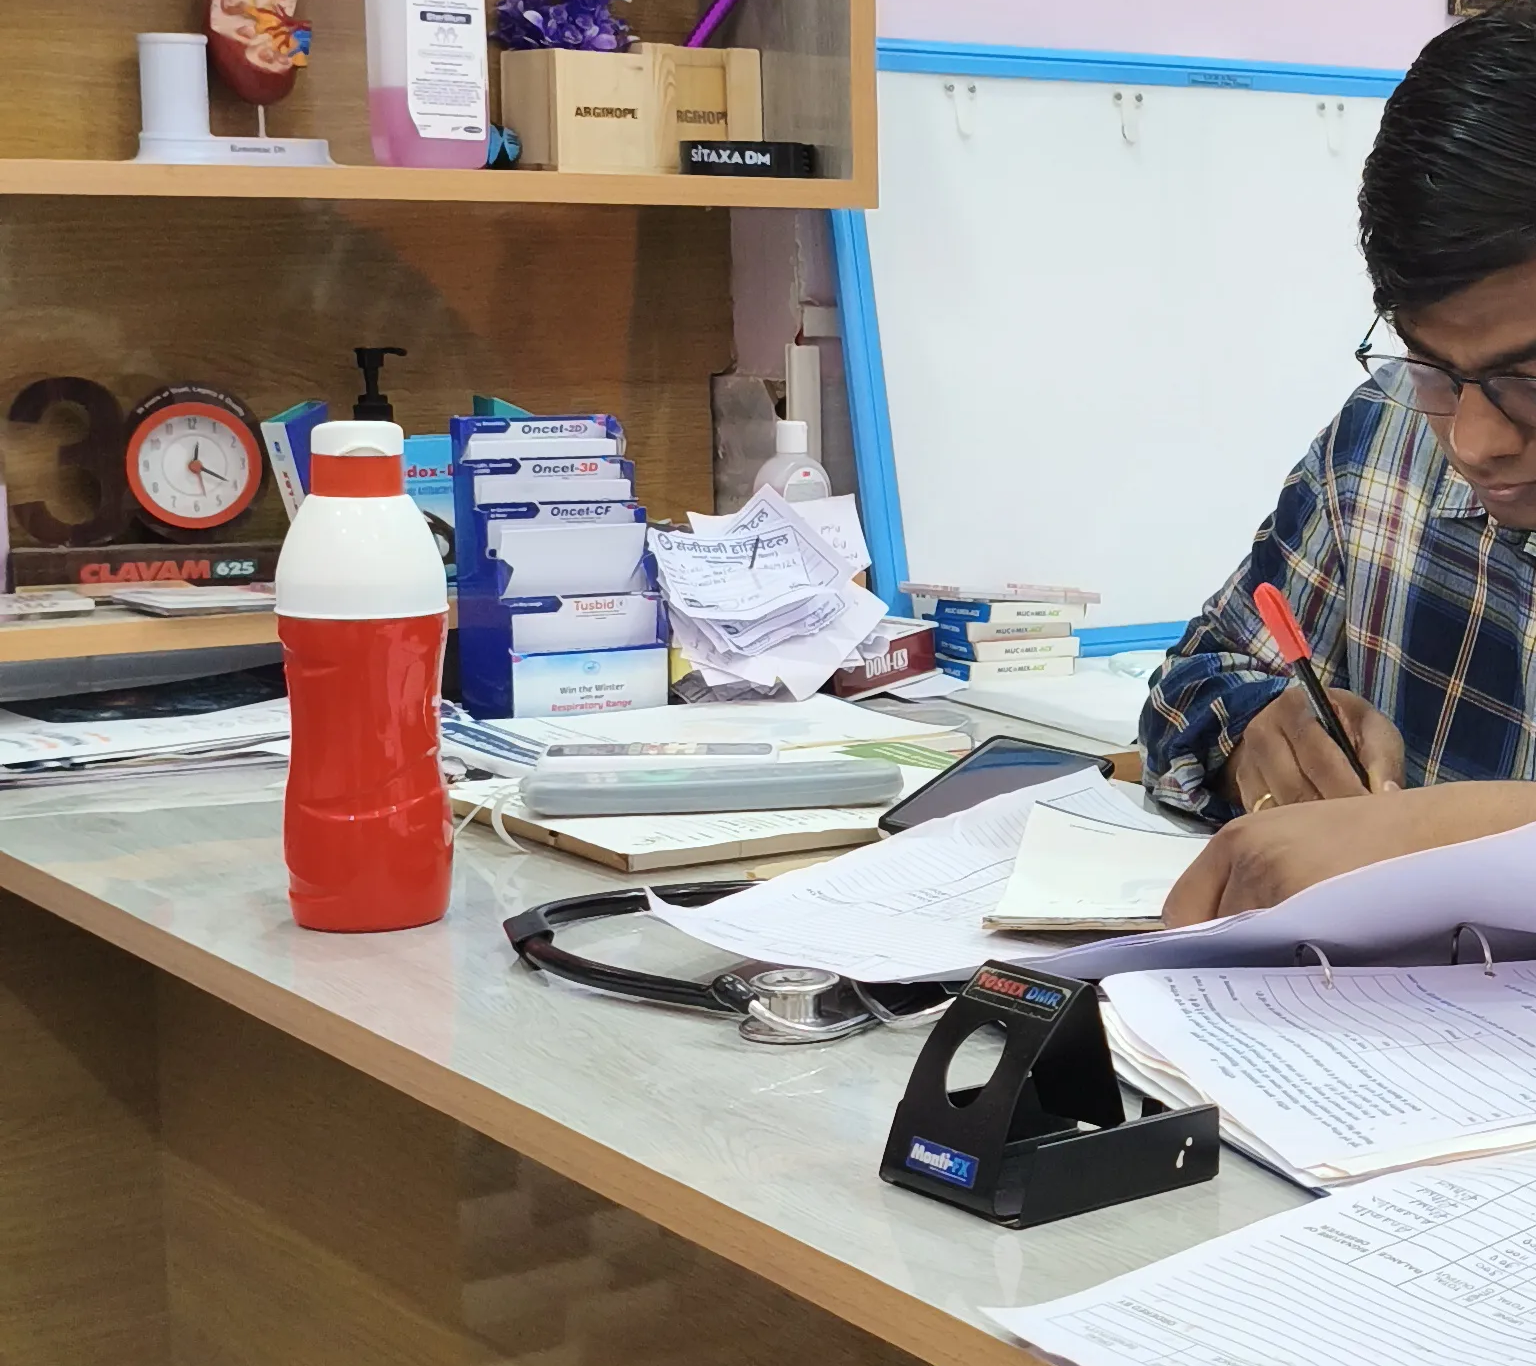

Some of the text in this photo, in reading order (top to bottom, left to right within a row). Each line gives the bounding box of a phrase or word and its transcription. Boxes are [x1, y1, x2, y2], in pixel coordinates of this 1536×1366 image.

[745, 151, 771, 166] DM
[187, 417, 197, 430] 12
[230, 436, 237, 447] 2
[193, 501, 200, 512] 6
[216, 496, 222, 506] 5
[675, 539, 728, 555] संजीवनी
[80, 560, 255, 582] CLAVAM 625
[574, 599, 615, 611] Tusbid
[560, 686, 577, 694] Win
[595, 683, 625, 692] Winter
[551, 700, 632, 712] Respiratory Range
[1025, 986, 1062, 1007] DMR
